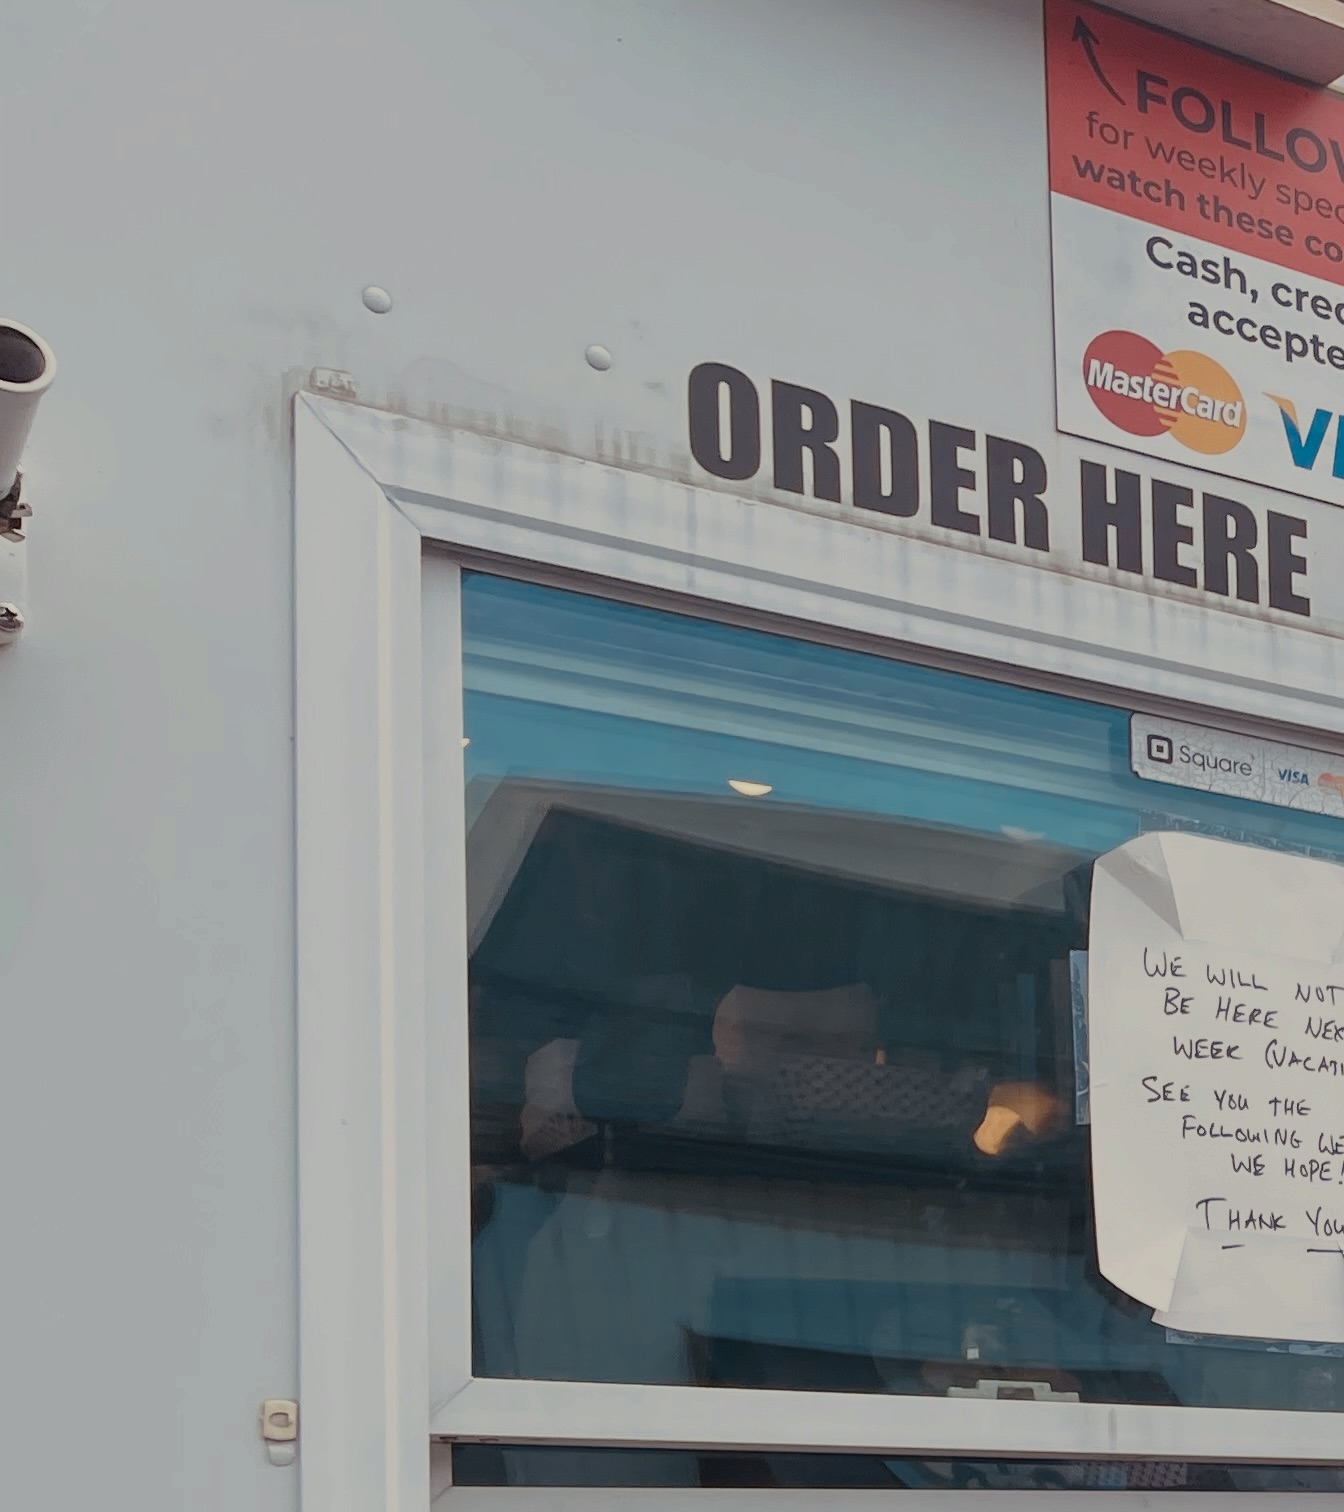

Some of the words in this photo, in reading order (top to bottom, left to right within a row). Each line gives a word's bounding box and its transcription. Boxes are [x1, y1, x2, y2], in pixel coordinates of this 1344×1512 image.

[1084, 110, 1135, 151] for
[1144, 136, 1267, 201] weekly
[1145, 235, 1259, 304] Cash,
[1087, 357, 1243, 429] MasterCard
[687, 361, 1051, 553] ORDER
[1080, 458, 1311, 618] HERE
[1179, 744, 1253, 777] Square
[1277, 767, 1310, 787] VISA
[1142, 946, 1187, 979] WE
[1205, 963, 1269, 992] WILL
[1163, 986, 1195, 1016] BE
[1214, 995, 1279, 1030] HERE
[1172, 1035, 1242, 1061] WEEK
